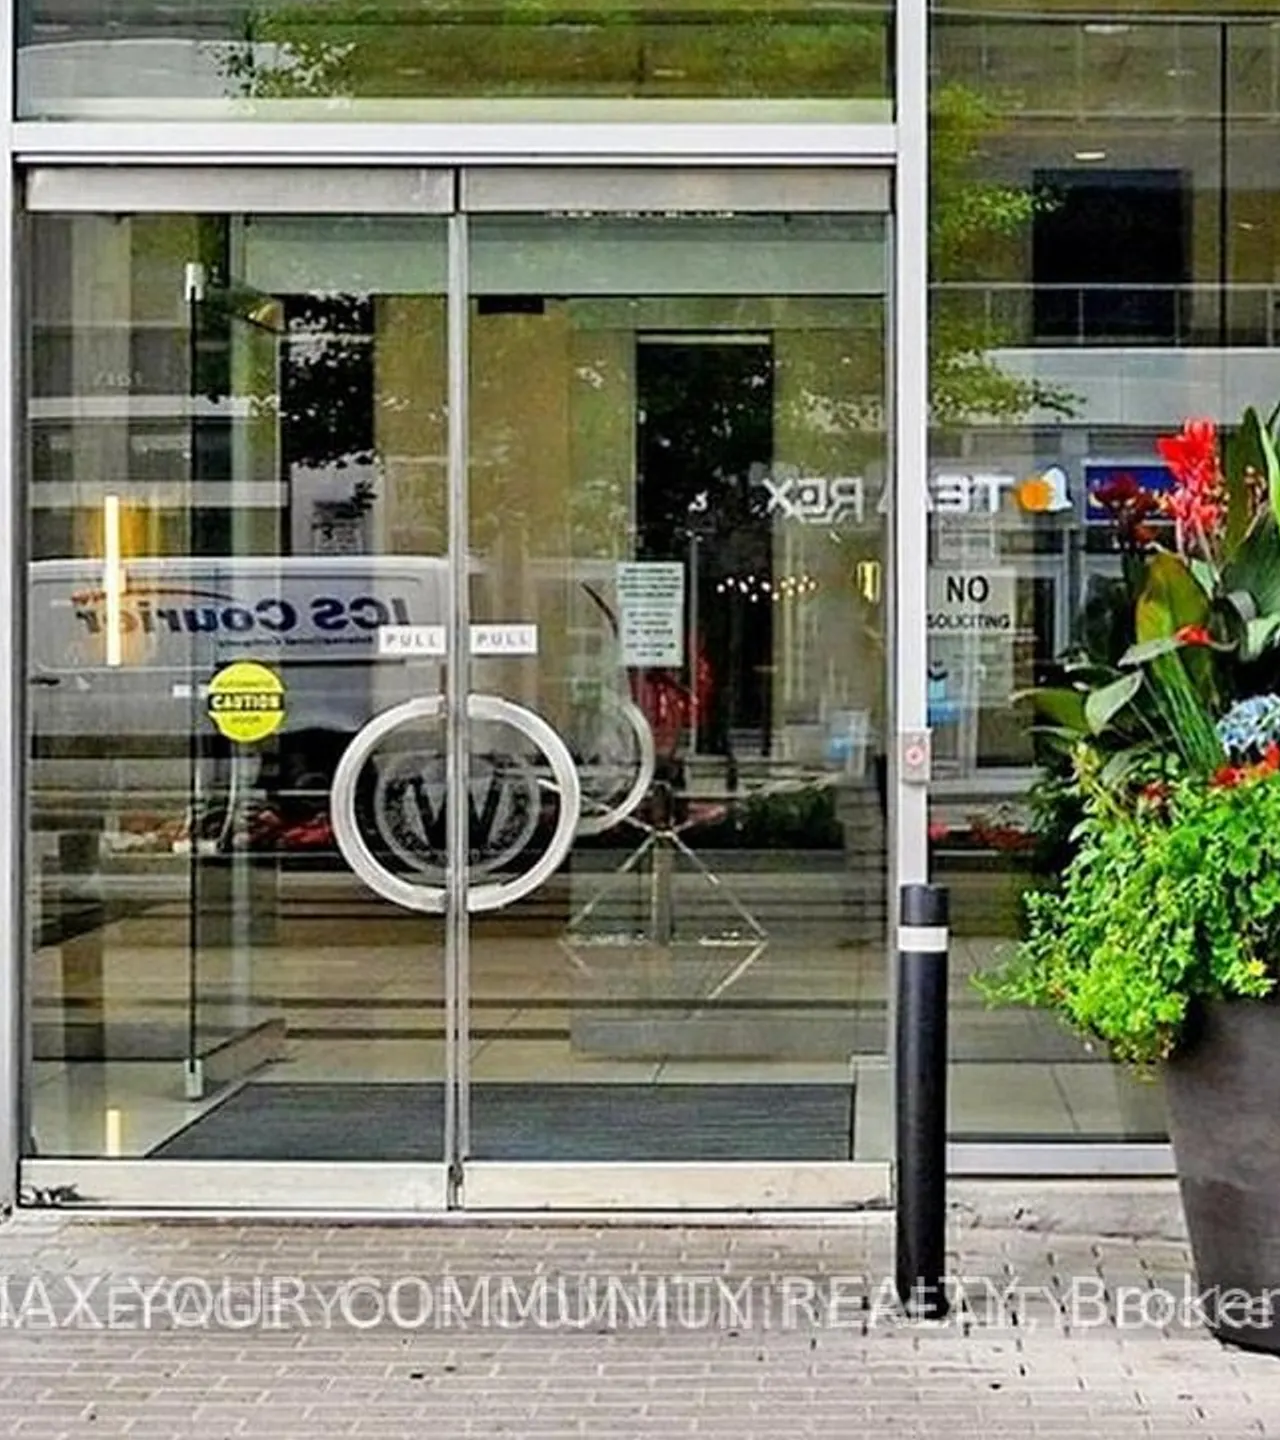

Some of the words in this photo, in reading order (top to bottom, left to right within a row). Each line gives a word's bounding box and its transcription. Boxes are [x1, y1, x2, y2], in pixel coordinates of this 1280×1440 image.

[946, 575, 990, 603] NO
[385, 633, 438, 647] PULL
[476, 632, 531, 647] PULL
[211, 694, 280, 709] CAUTION
